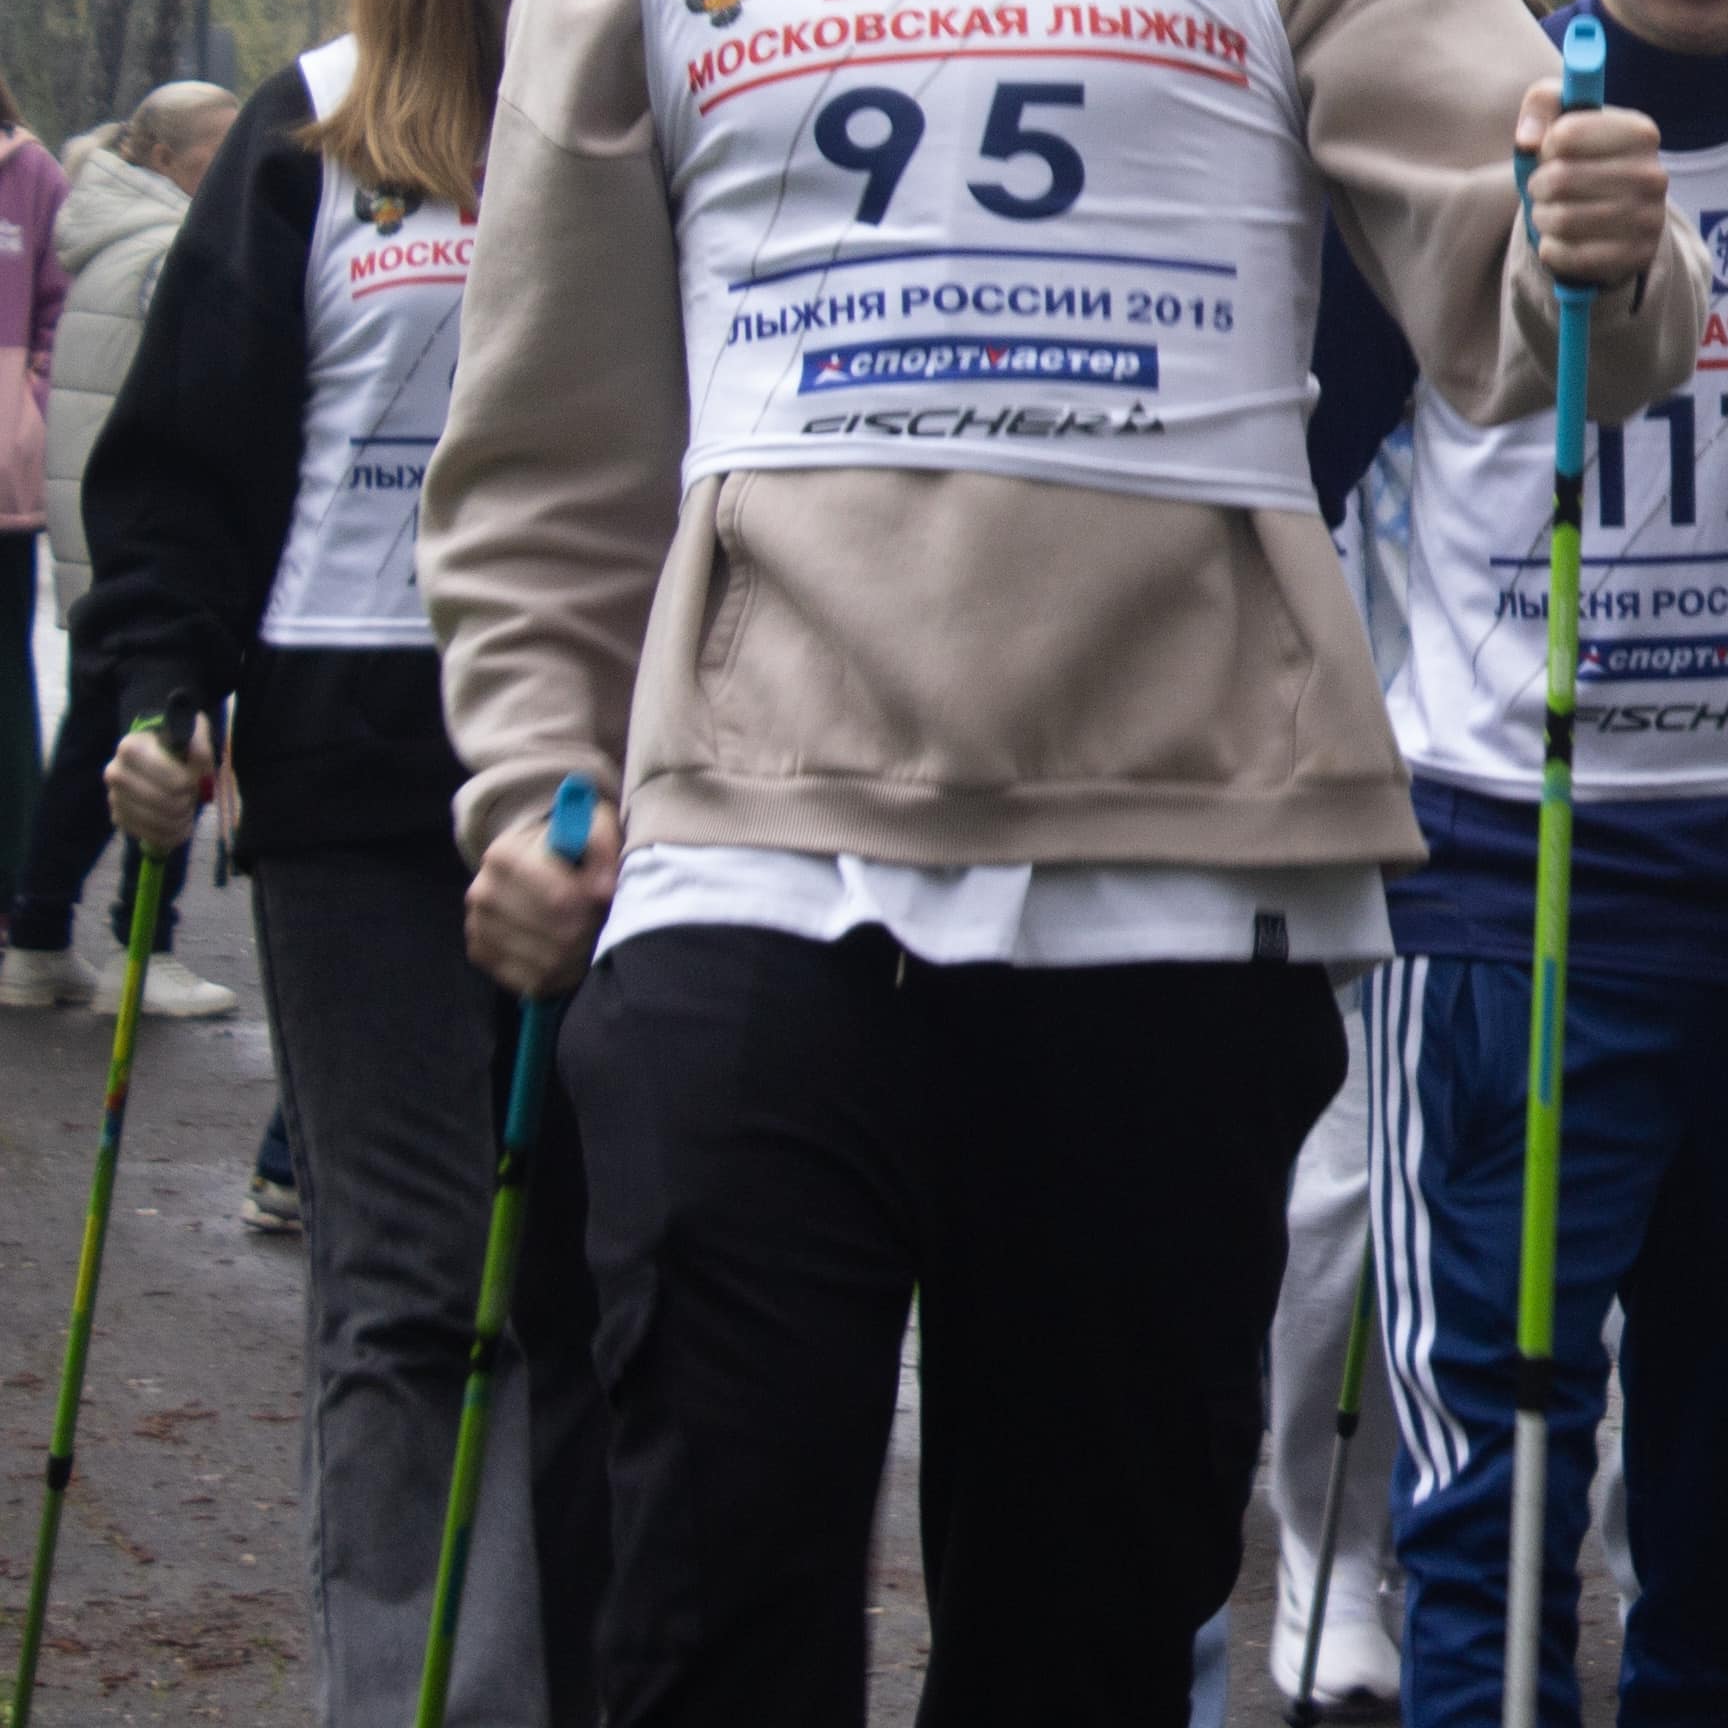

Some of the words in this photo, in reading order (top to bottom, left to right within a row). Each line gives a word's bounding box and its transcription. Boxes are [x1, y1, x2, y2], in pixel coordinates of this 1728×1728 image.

[687, 5, 1029, 95] МОСКОВСКАЯ
[1046, 4, 1249, 67] ЛЫЖНЯ
[814, 81, 1086, 227] 95
[350, 238, 474, 283] МОСКО
[727, 286, 887, 345] ЛЫЖНЯ
[901, 282, 1112, 320] РОССИИ
[1126, 292, 1236, 332] 2015
[850, 341, 1140, 379] спортмастер
[802, 404, 1108, 437] FISCHER
[348, 463, 427, 490] ЛЫЖ
[1495, 588, 1641, 621] ЛЫНЯ
